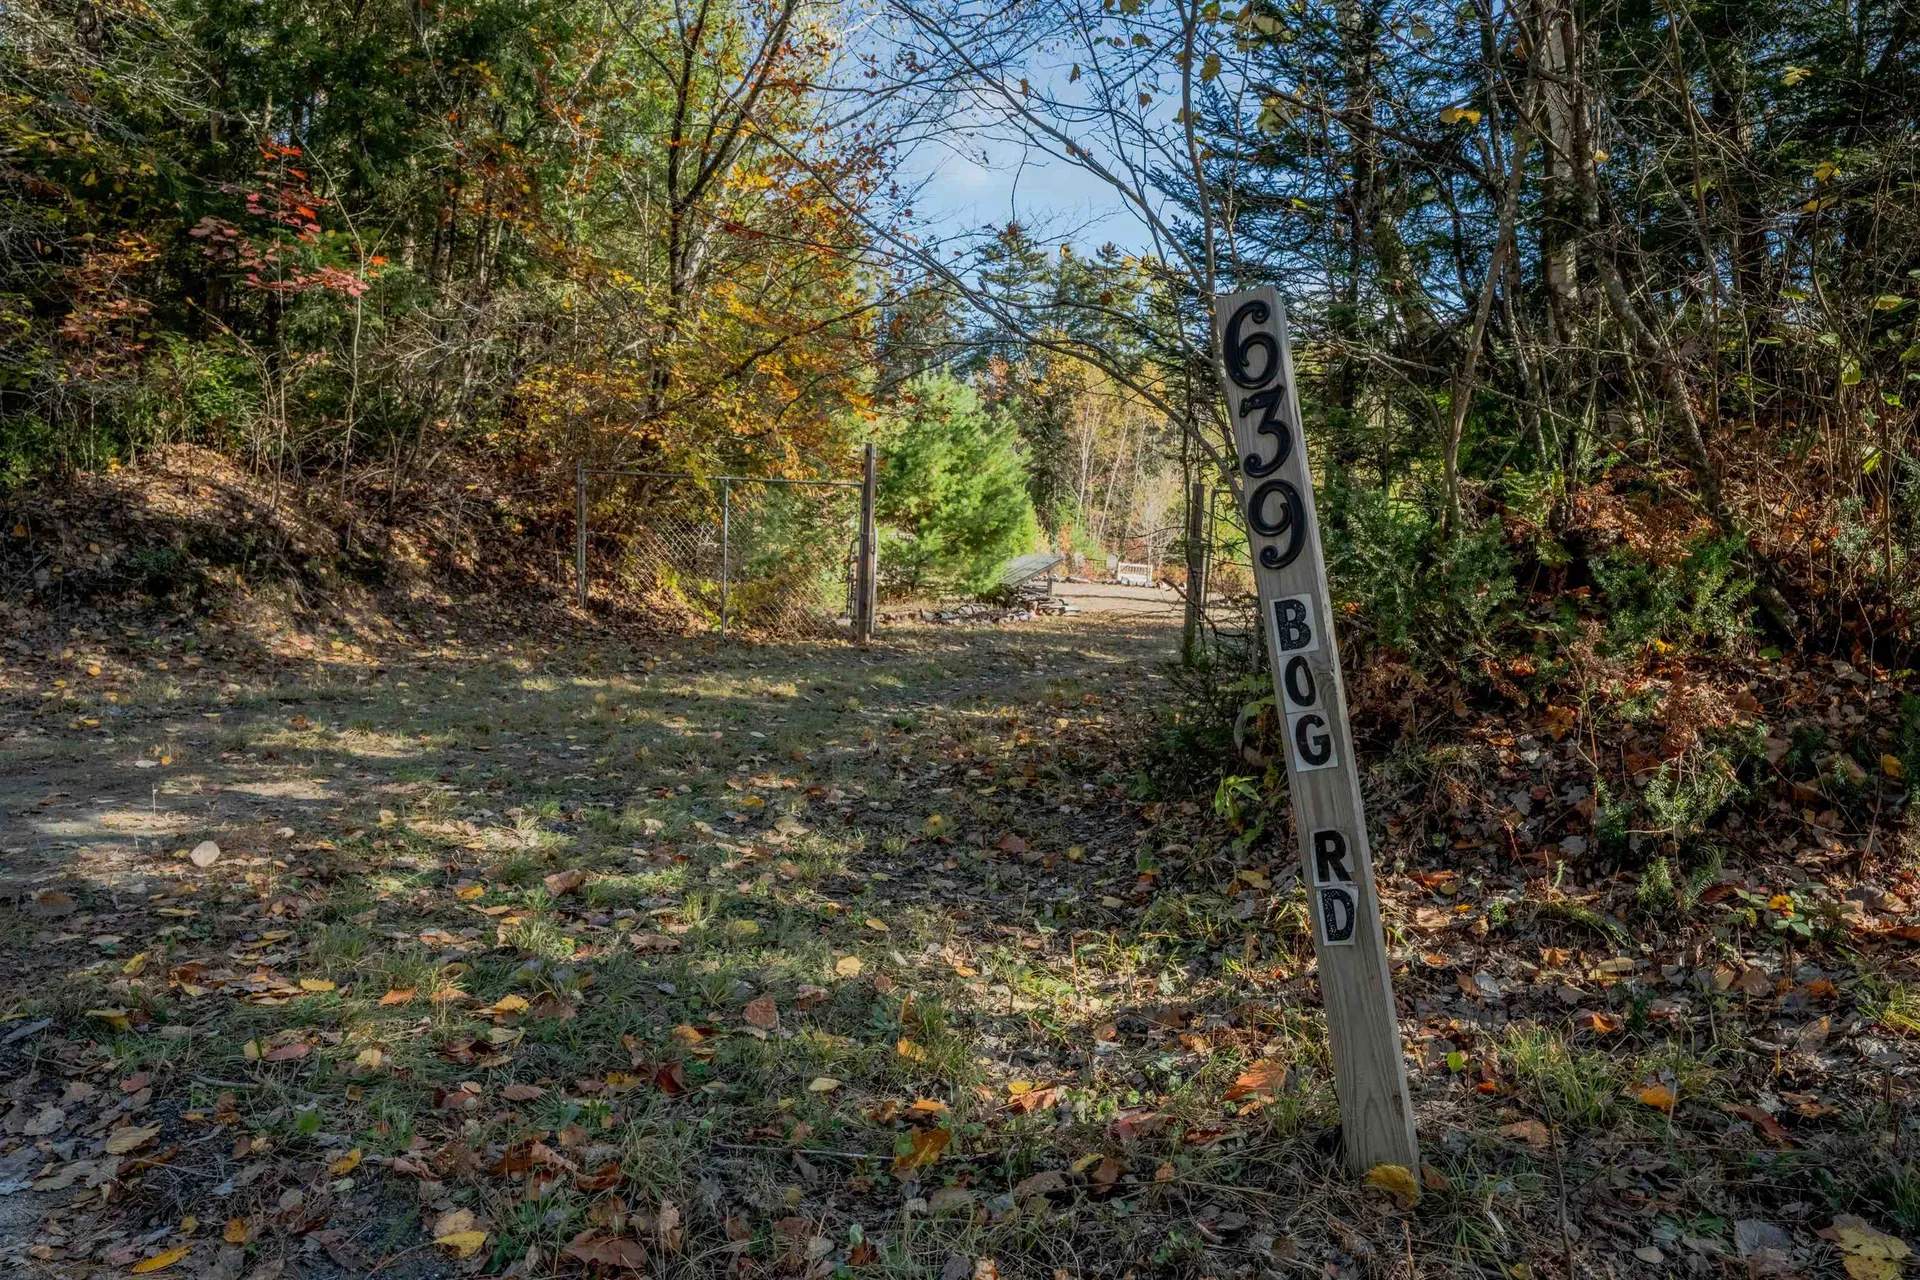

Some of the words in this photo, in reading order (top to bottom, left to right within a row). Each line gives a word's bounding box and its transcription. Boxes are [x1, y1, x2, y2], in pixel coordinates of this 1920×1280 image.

[1223, 300, 1308, 570] 639
[1274, 598, 1332, 766] BOG
[1314, 830, 1355, 942] RD
